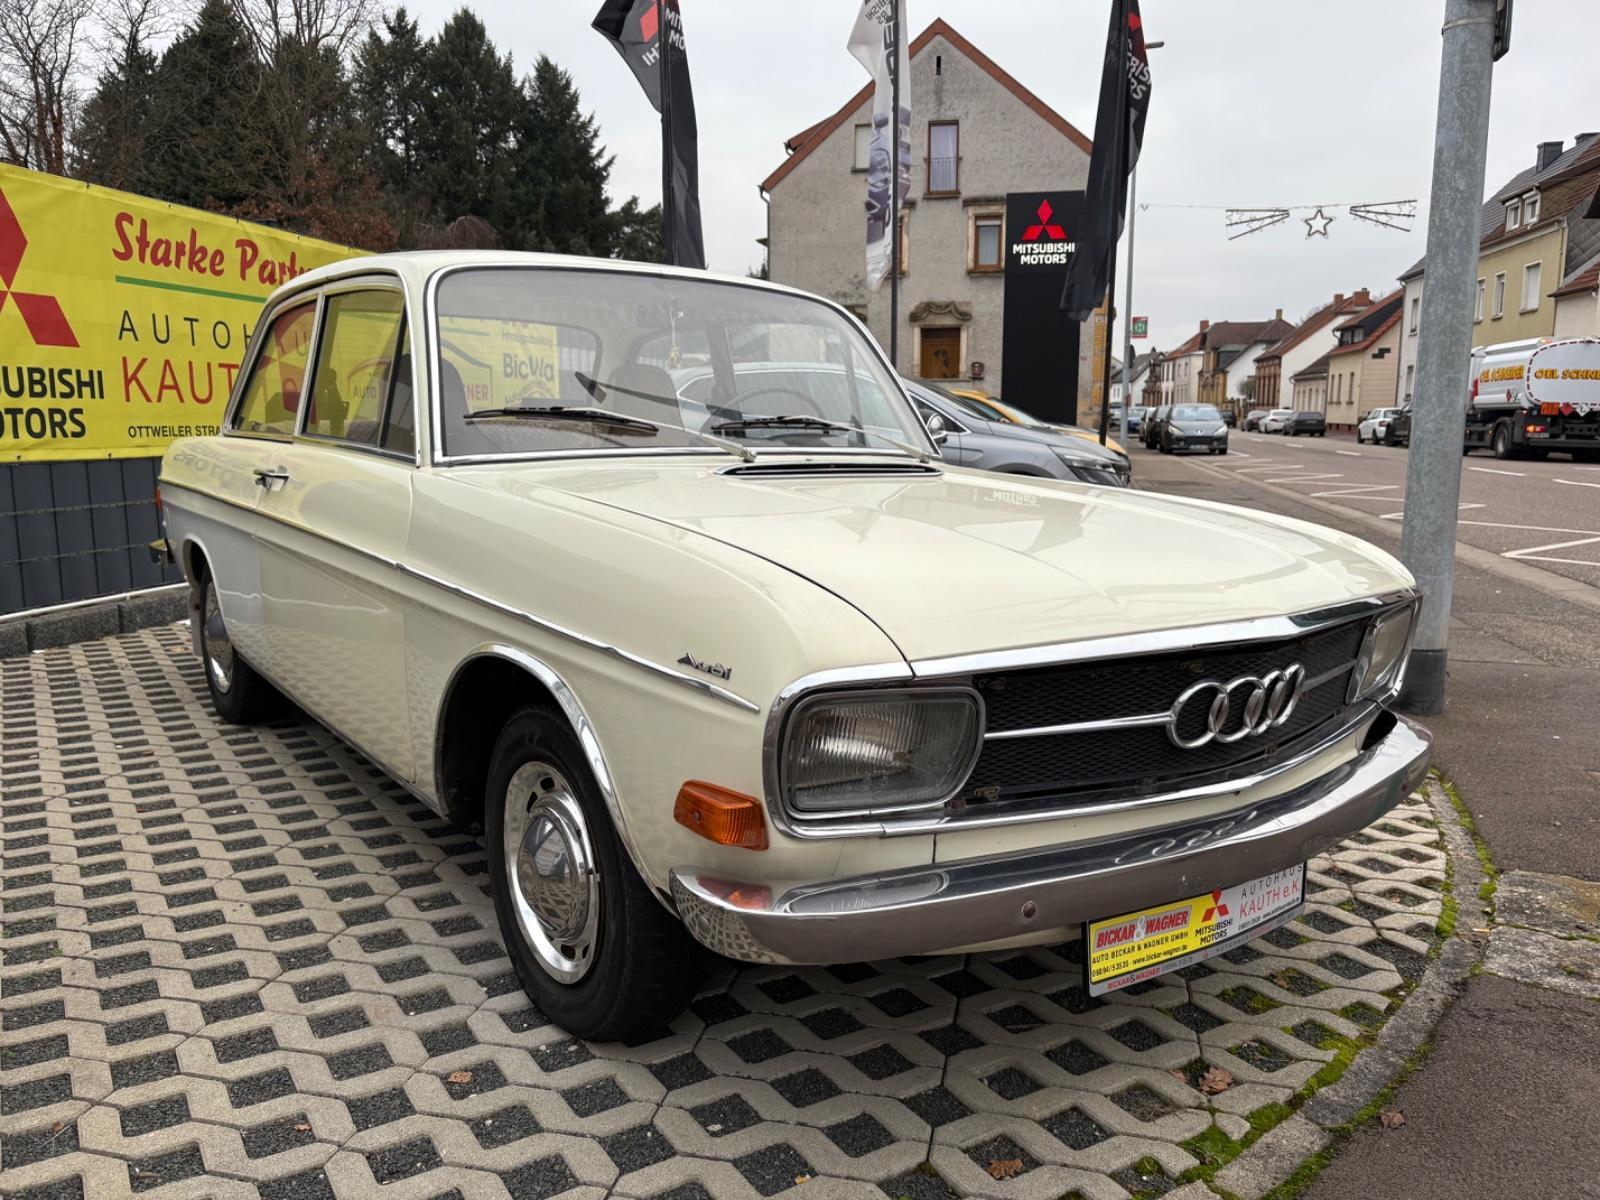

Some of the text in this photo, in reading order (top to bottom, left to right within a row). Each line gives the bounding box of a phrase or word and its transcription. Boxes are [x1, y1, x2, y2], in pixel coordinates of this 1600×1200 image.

[113, 211, 225, 277] Starke
[1012, 243, 1075, 254] MITSUBISHI
[1020, 254, 1067, 265] MOTORS
[0, 366, 104, 400] UBISHI
[121, 356, 240, 405] KAUT
[1535, 369, 1558, 379] OEL
[0, 407, 86, 438] TORS
[128, 425, 192, 438] OTTWEILER
[677, 652, 732, 680] Audi
[1241, 866, 1303, 899] AUTOHAUS
[1239, 887, 1280, 919] KAUTH
[1096, 924, 1136, 949] BICKAR
[1145, 910, 1189, 935] WAGNER
[1195, 917, 1233, 938] MITSUBISHI
[1200, 929, 1228, 945] MOTORS
[1092, 953, 1109, 965] AUTO
[1111, 946, 1136, 959] BICKAR
[1144, 937, 1170, 949] WAGNER
